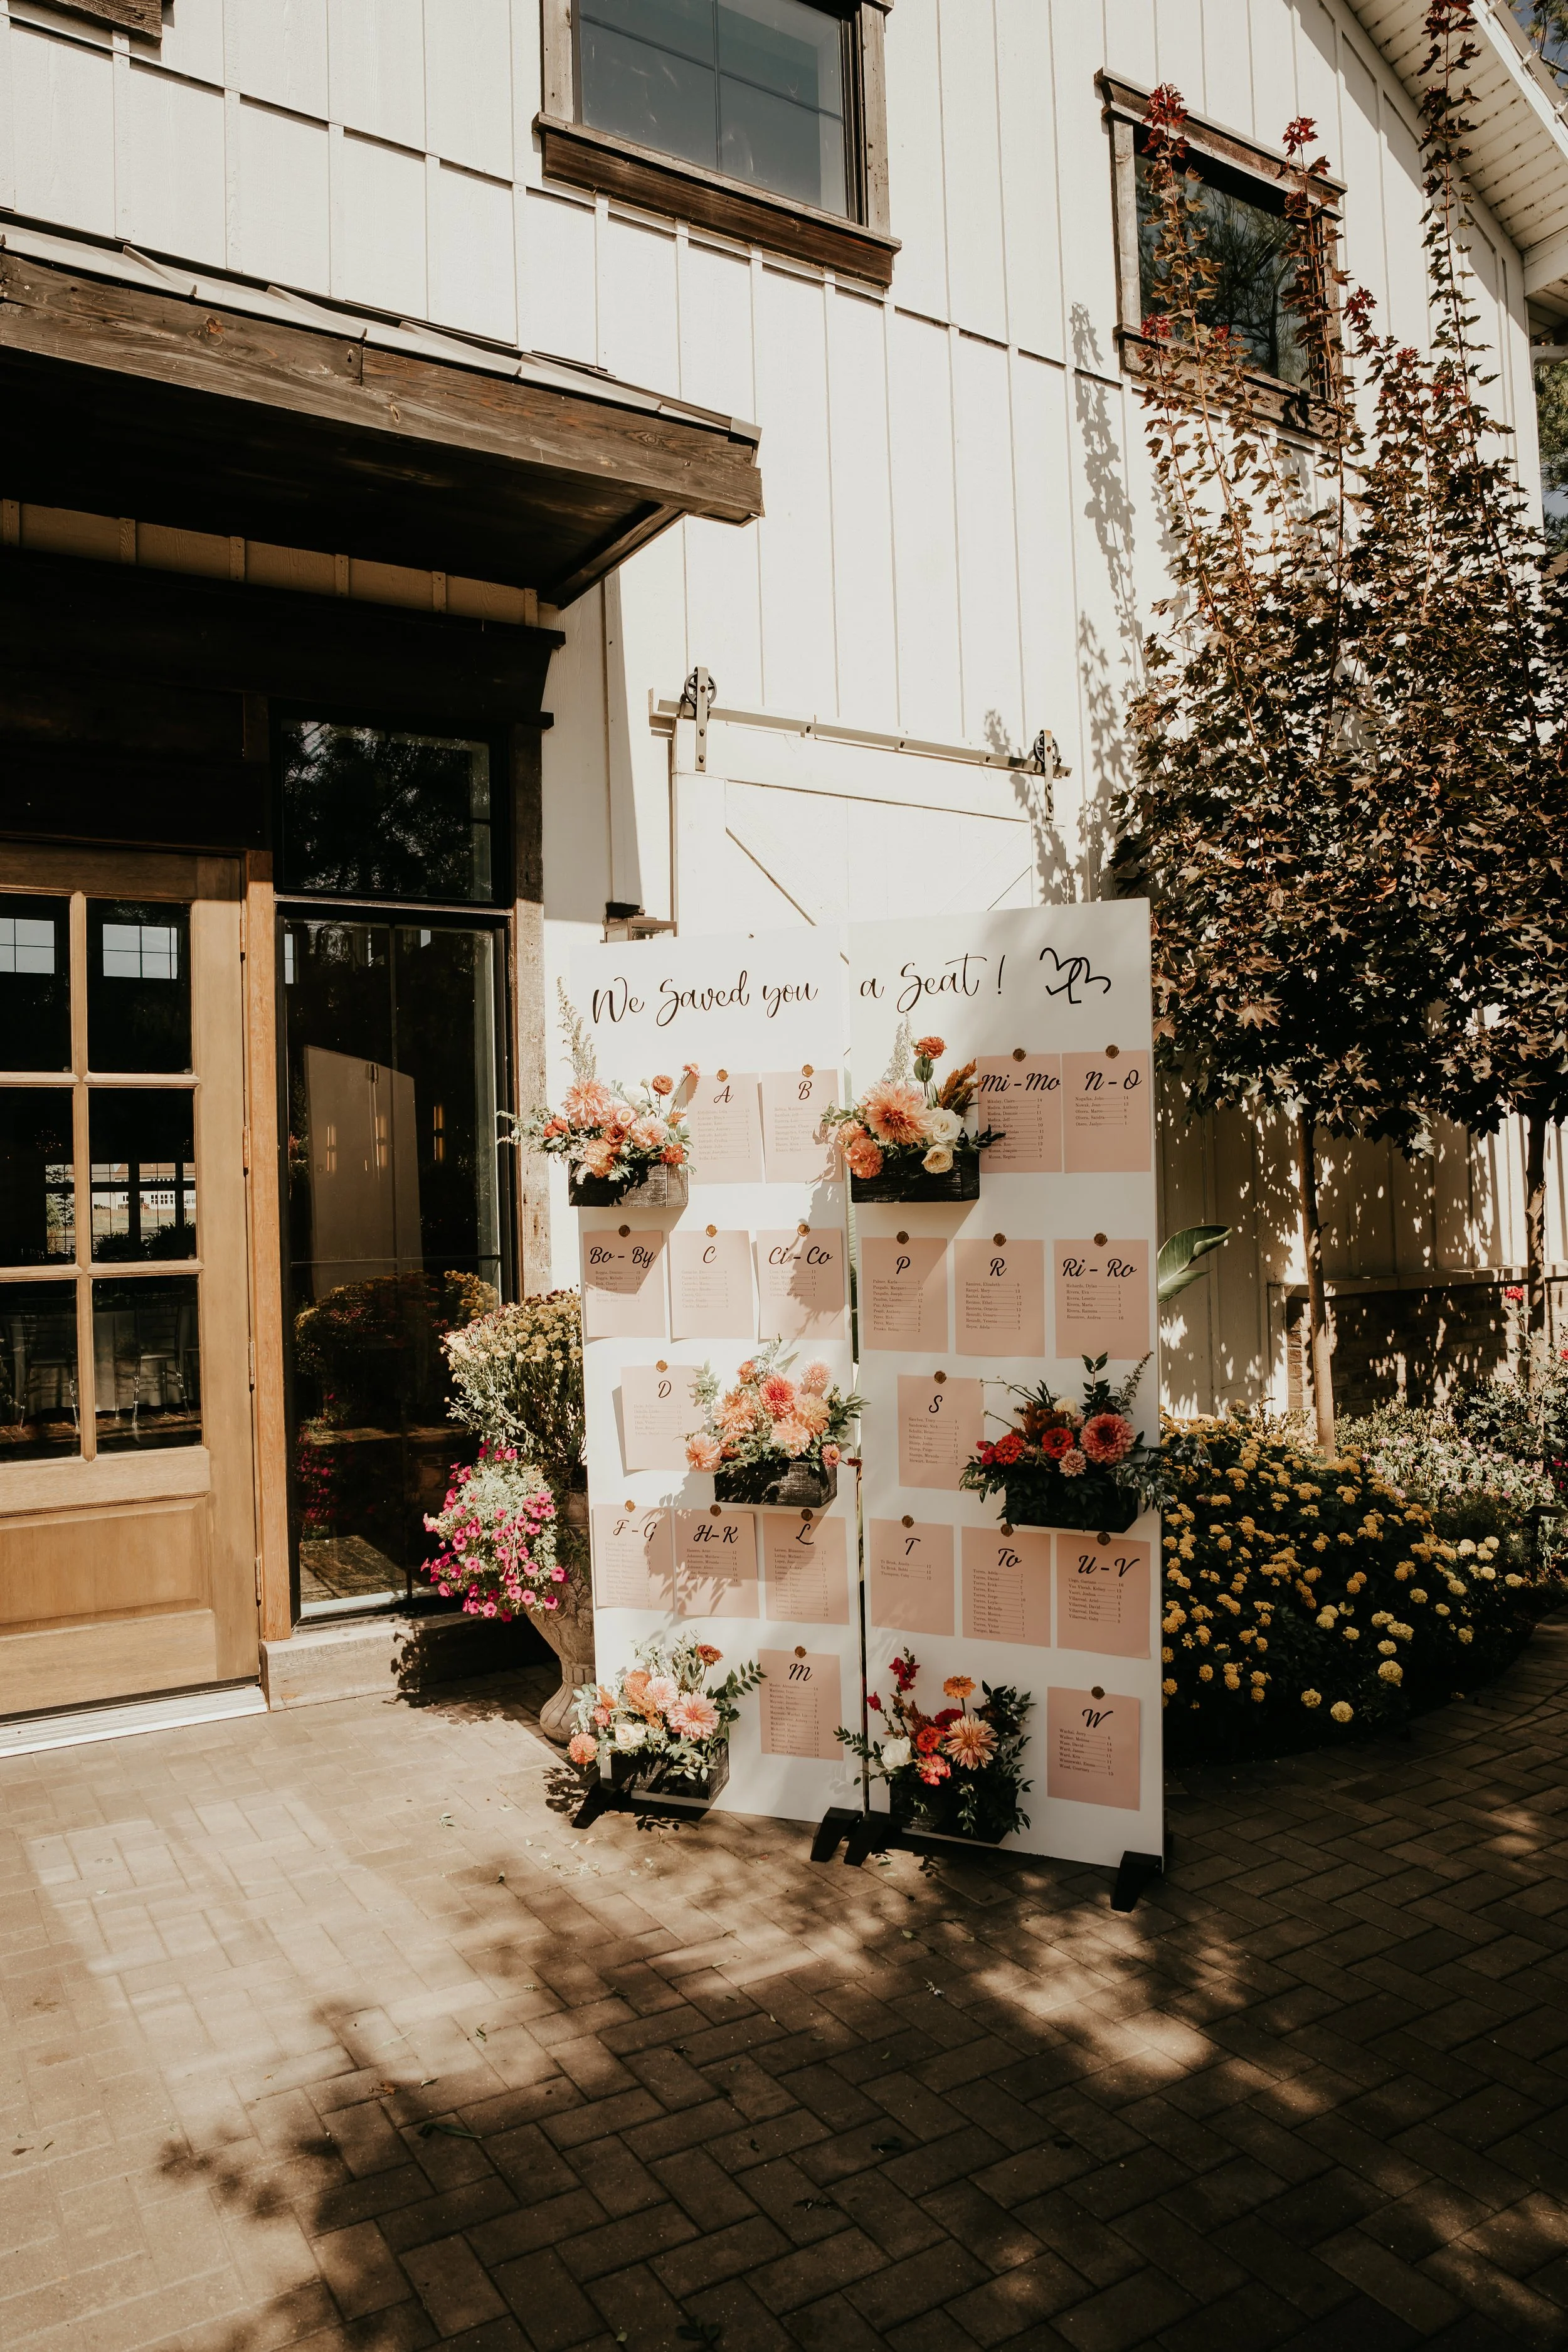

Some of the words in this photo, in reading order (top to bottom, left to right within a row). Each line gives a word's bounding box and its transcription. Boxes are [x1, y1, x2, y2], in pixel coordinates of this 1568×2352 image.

[593, 977, 645, 1024] We
[656, 970, 750, 1027] Saved
[762, 982, 818, 1018] you
[860, 977, 885, 999] a
[896, 953, 987, 1013] Seat
[713, 1085, 734, 1103] A
[798, 1081, 812, 1100] B
[702, 1246, 717, 1264] C
[896, 1256, 911, 1274] P
[989, 1258, 1007, 1276] R
[658, 1380, 672, 1398] D
[928, 1394, 943, 1413] S
[795, 1523, 814, 1545] L
[905, 1537, 921, 1555] T
[998, 1548, 1022, 1567] To
[788, 1663, 813, 1682] M
[1082, 1708, 1114, 1728] W
